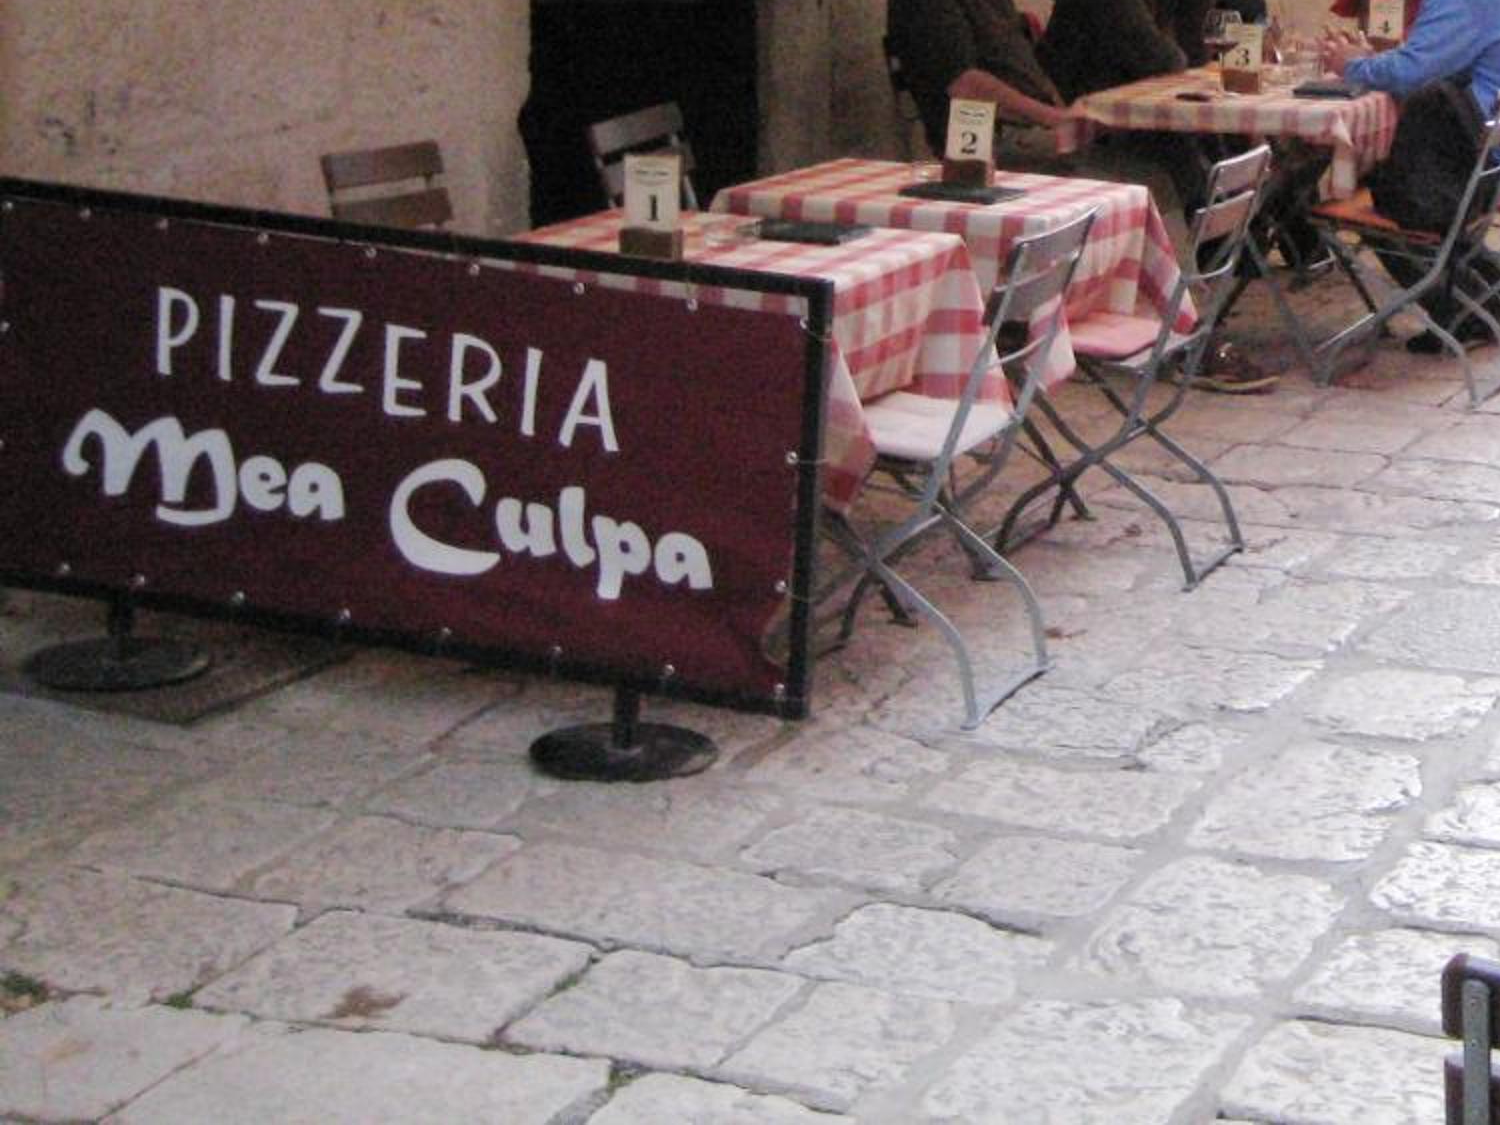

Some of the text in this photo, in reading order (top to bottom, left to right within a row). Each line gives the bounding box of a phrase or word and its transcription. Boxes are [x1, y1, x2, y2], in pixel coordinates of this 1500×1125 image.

[960, 131, 978, 154] 2
[648, 194, 660, 221] 1
[155, 286, 620, 453] PIZZERIA
[61, 408, 714, 601] Mea Culpa
